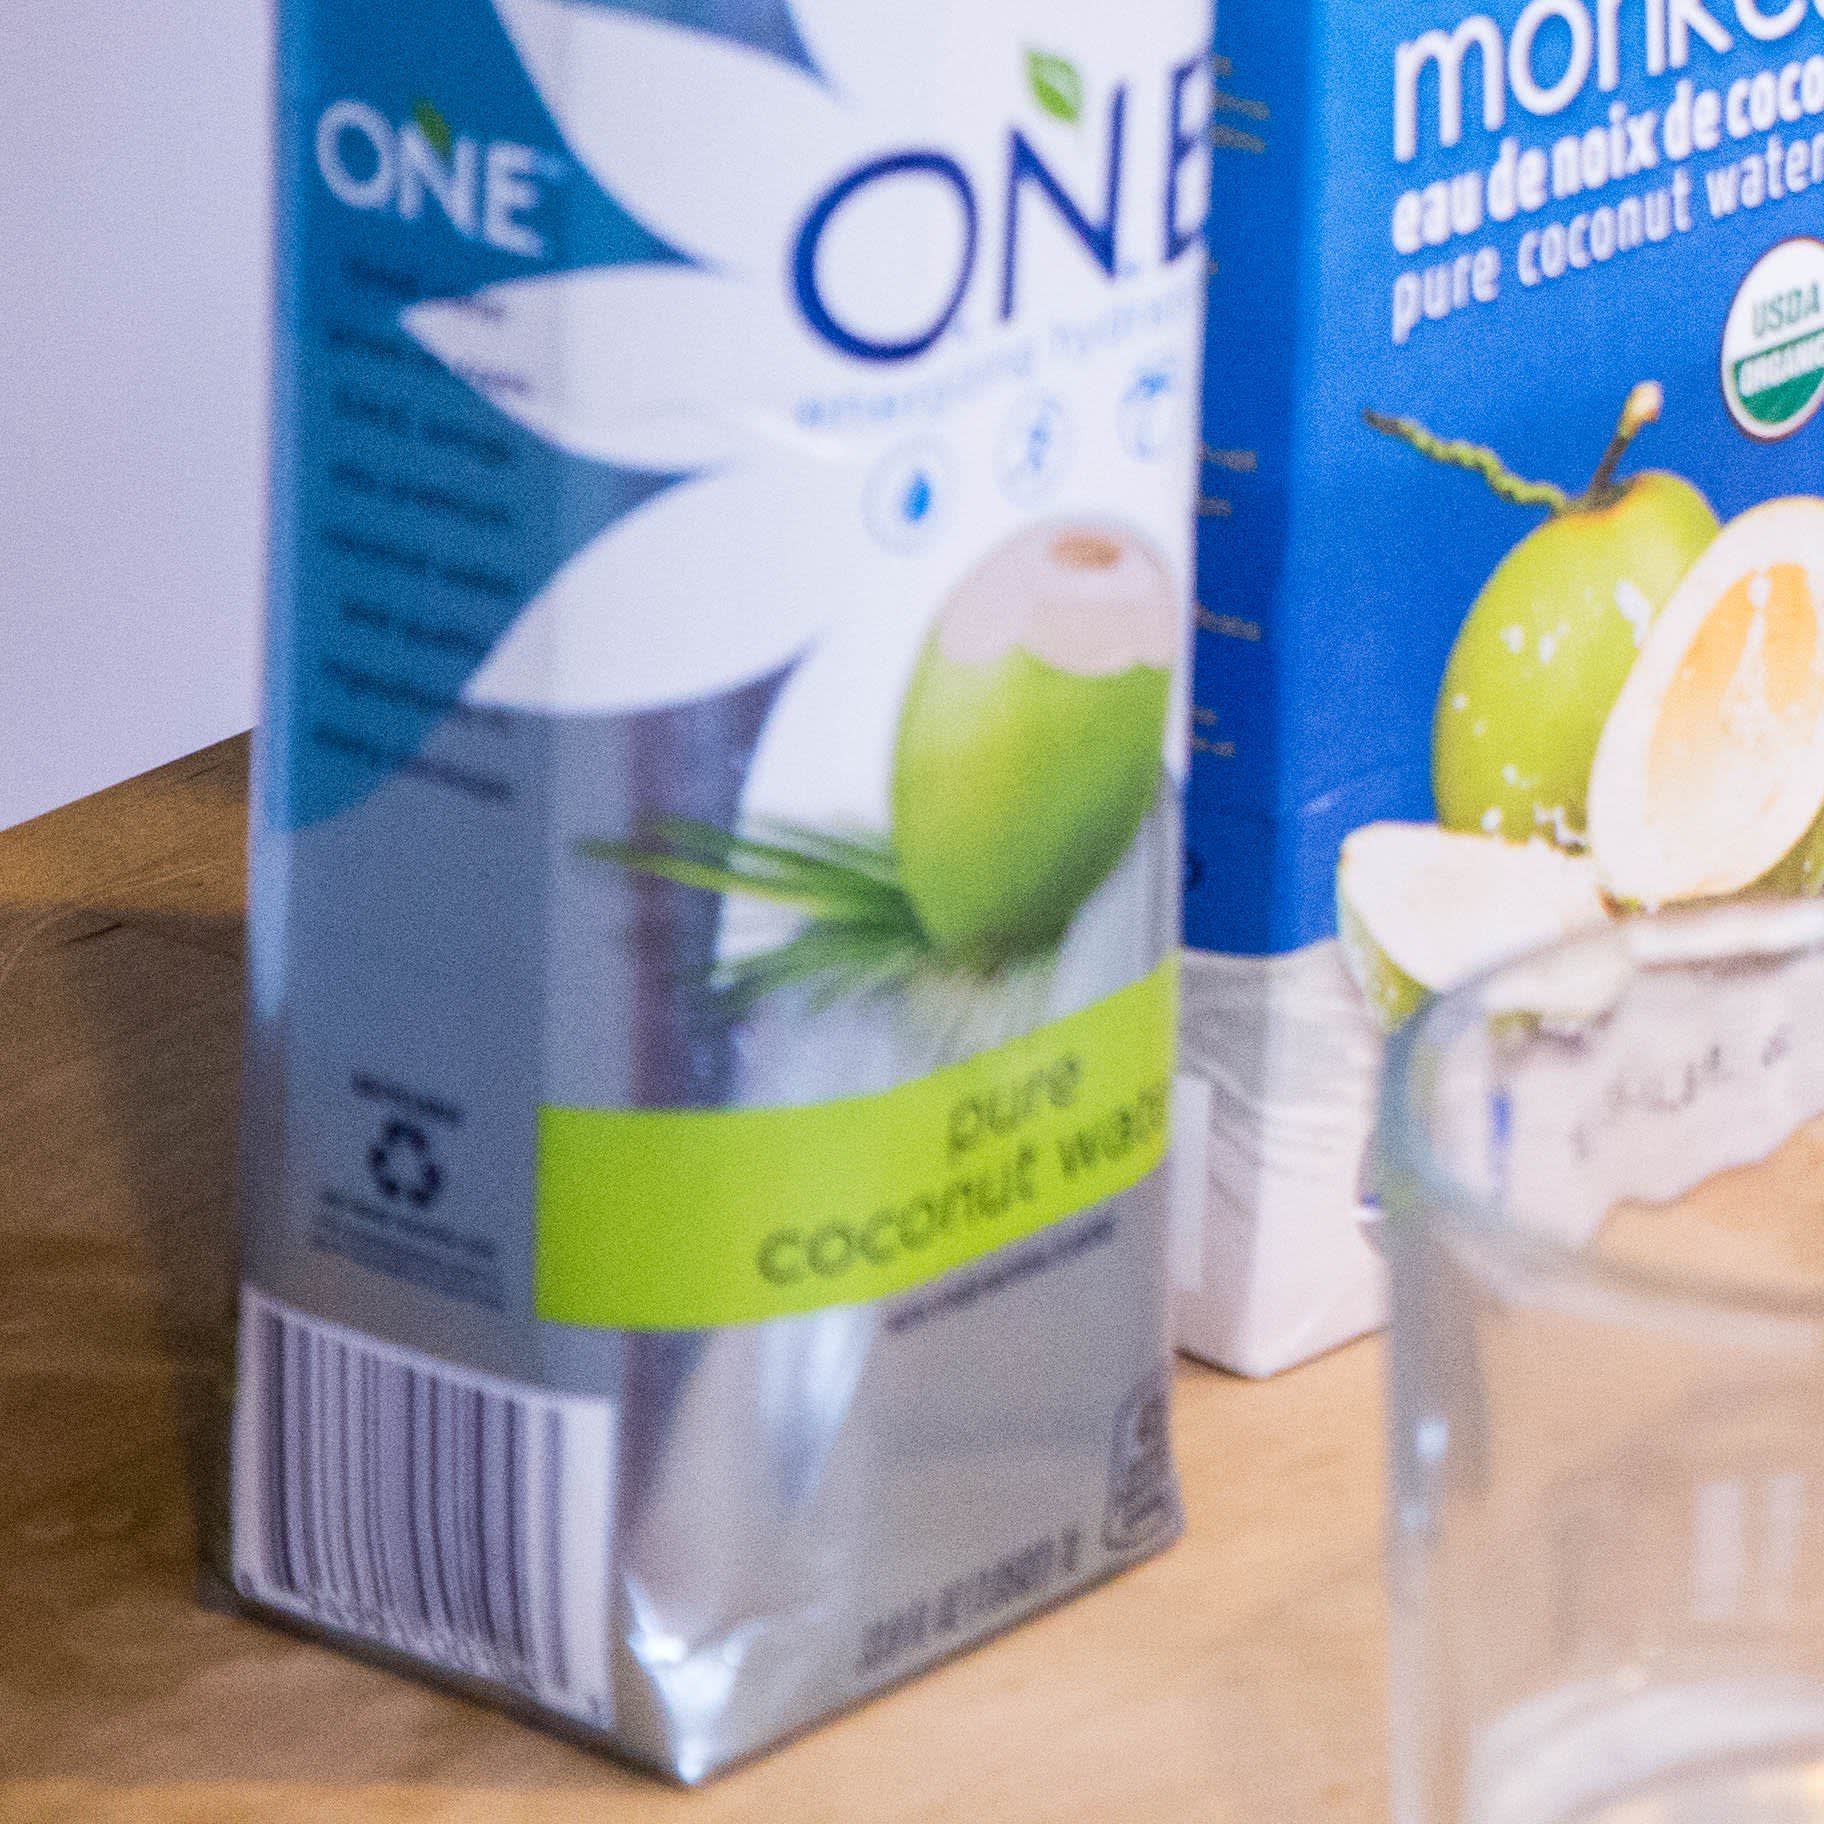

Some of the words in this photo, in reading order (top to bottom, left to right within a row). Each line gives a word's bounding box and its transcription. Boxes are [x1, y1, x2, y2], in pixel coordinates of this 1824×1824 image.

[316, 97, 547, 259] ONE
[1394, 173, 1481, 254] eau
[1488, 137, 1547, 221] de
[1551, 101, 1660, 198] noix
[1664, 79, 1721, 162] de
[1392, 246, 1499, 345] pure
[1516, 170, 1692, 287] coconut
[1752, 287, 1822, 338] USDA
[945, 1055, 1082, 1167] pure
[755, 1147, 1045, 1290] coconut
